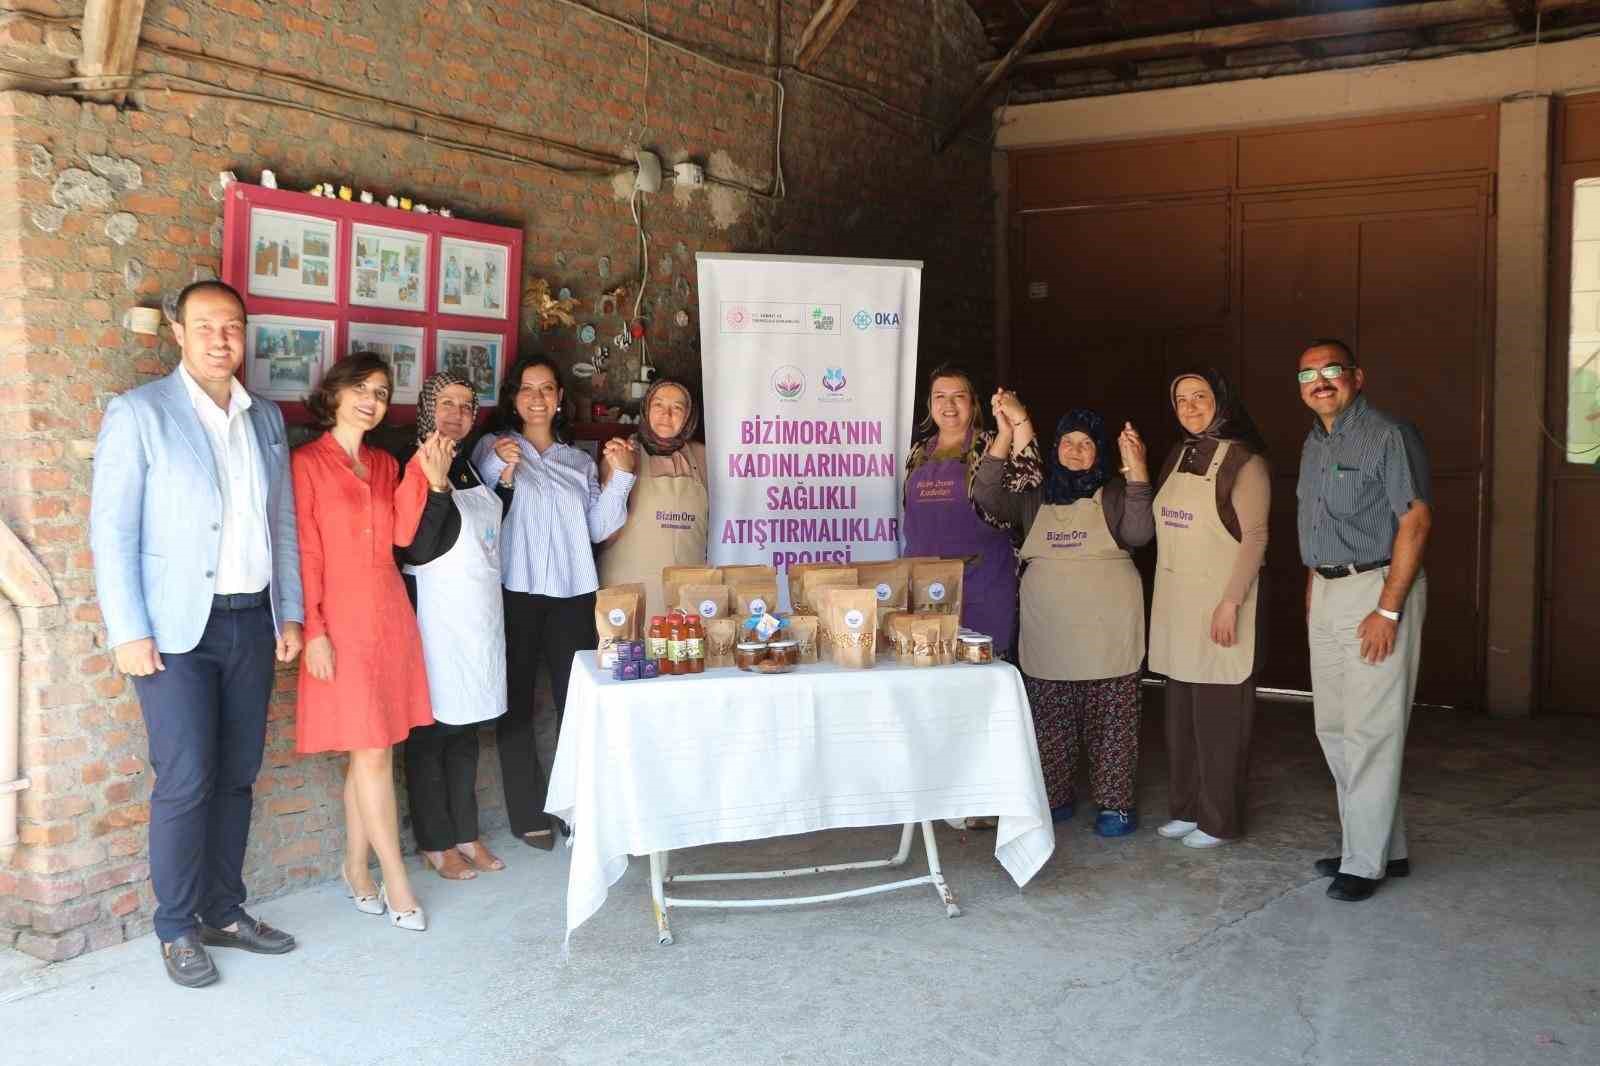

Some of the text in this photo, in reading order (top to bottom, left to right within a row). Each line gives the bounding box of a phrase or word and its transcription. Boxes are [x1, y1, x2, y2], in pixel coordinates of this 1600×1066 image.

[875, 312, 899, 325] OKA
[741, 415, 882, 445] BİZİMORA'NIN
[728, 453, 894, 477] KADINLARINDAN
[766, 482, 856, 510] SAĞLIKLI
[721, 518, 899, 550] ATIŞTIRMALIKLAR
